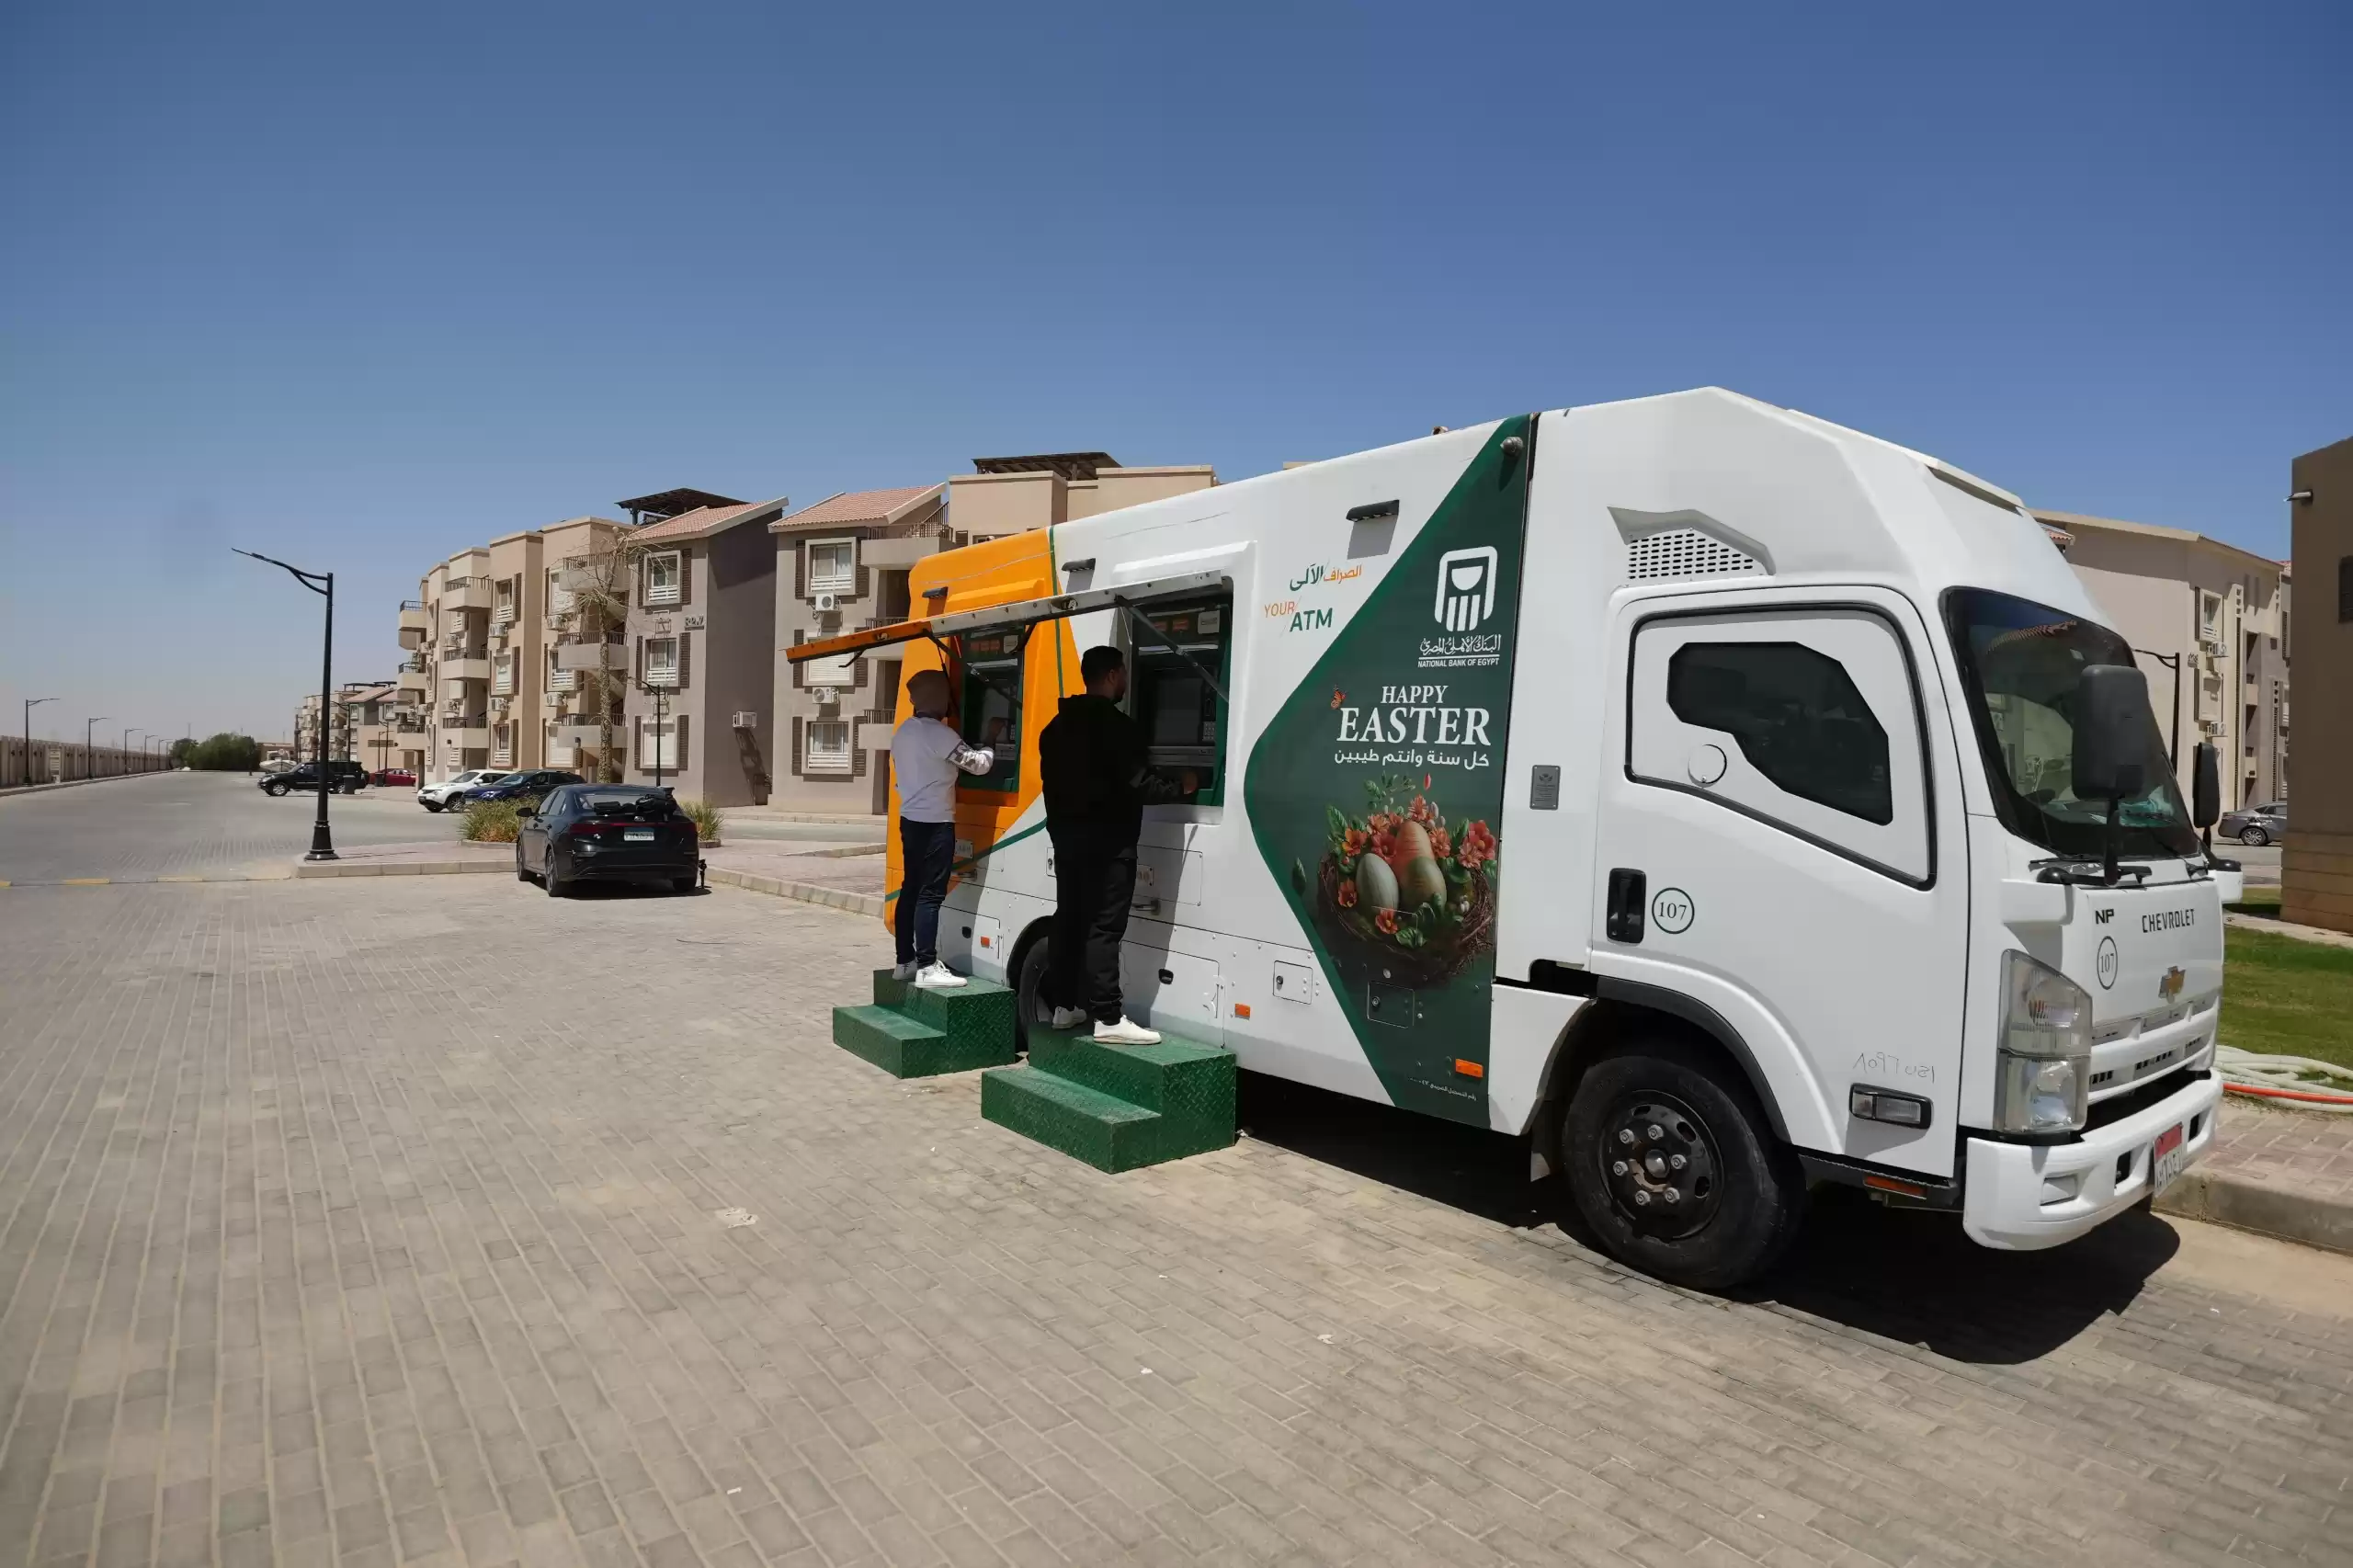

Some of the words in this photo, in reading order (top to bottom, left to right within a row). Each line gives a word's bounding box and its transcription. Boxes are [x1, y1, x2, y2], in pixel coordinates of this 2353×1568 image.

[1323, 563, 1362, 585] الصراف
[1264, 600, 1295, 618] YOUR
[1290, 607, 1333, 632] ATM
[1417, 660, 1448, 668] NATIONAL
[1448, 658, 1466, 667] BANK
[1467, 658, 1477, 666] OF
[1477, 657, 1499, 665] EGYPT
[1381, 685, 1449, 704] HAPPY
[1336, 707, 1492, 746] EASTER
[1335, 748, 1380, 764] طيبين
[1382, 749, 1424, 767] وانتم
[1427, 750, 1461, 766] سنة
[1463, 751, 1490, 770] كل
[1658, 902, 1688, 921] 107
[2095, 908, 2115, 925] NP
[2142, 908, 2195, 934] CHEVROLET
[2100, 953, 2115, 973] 107
